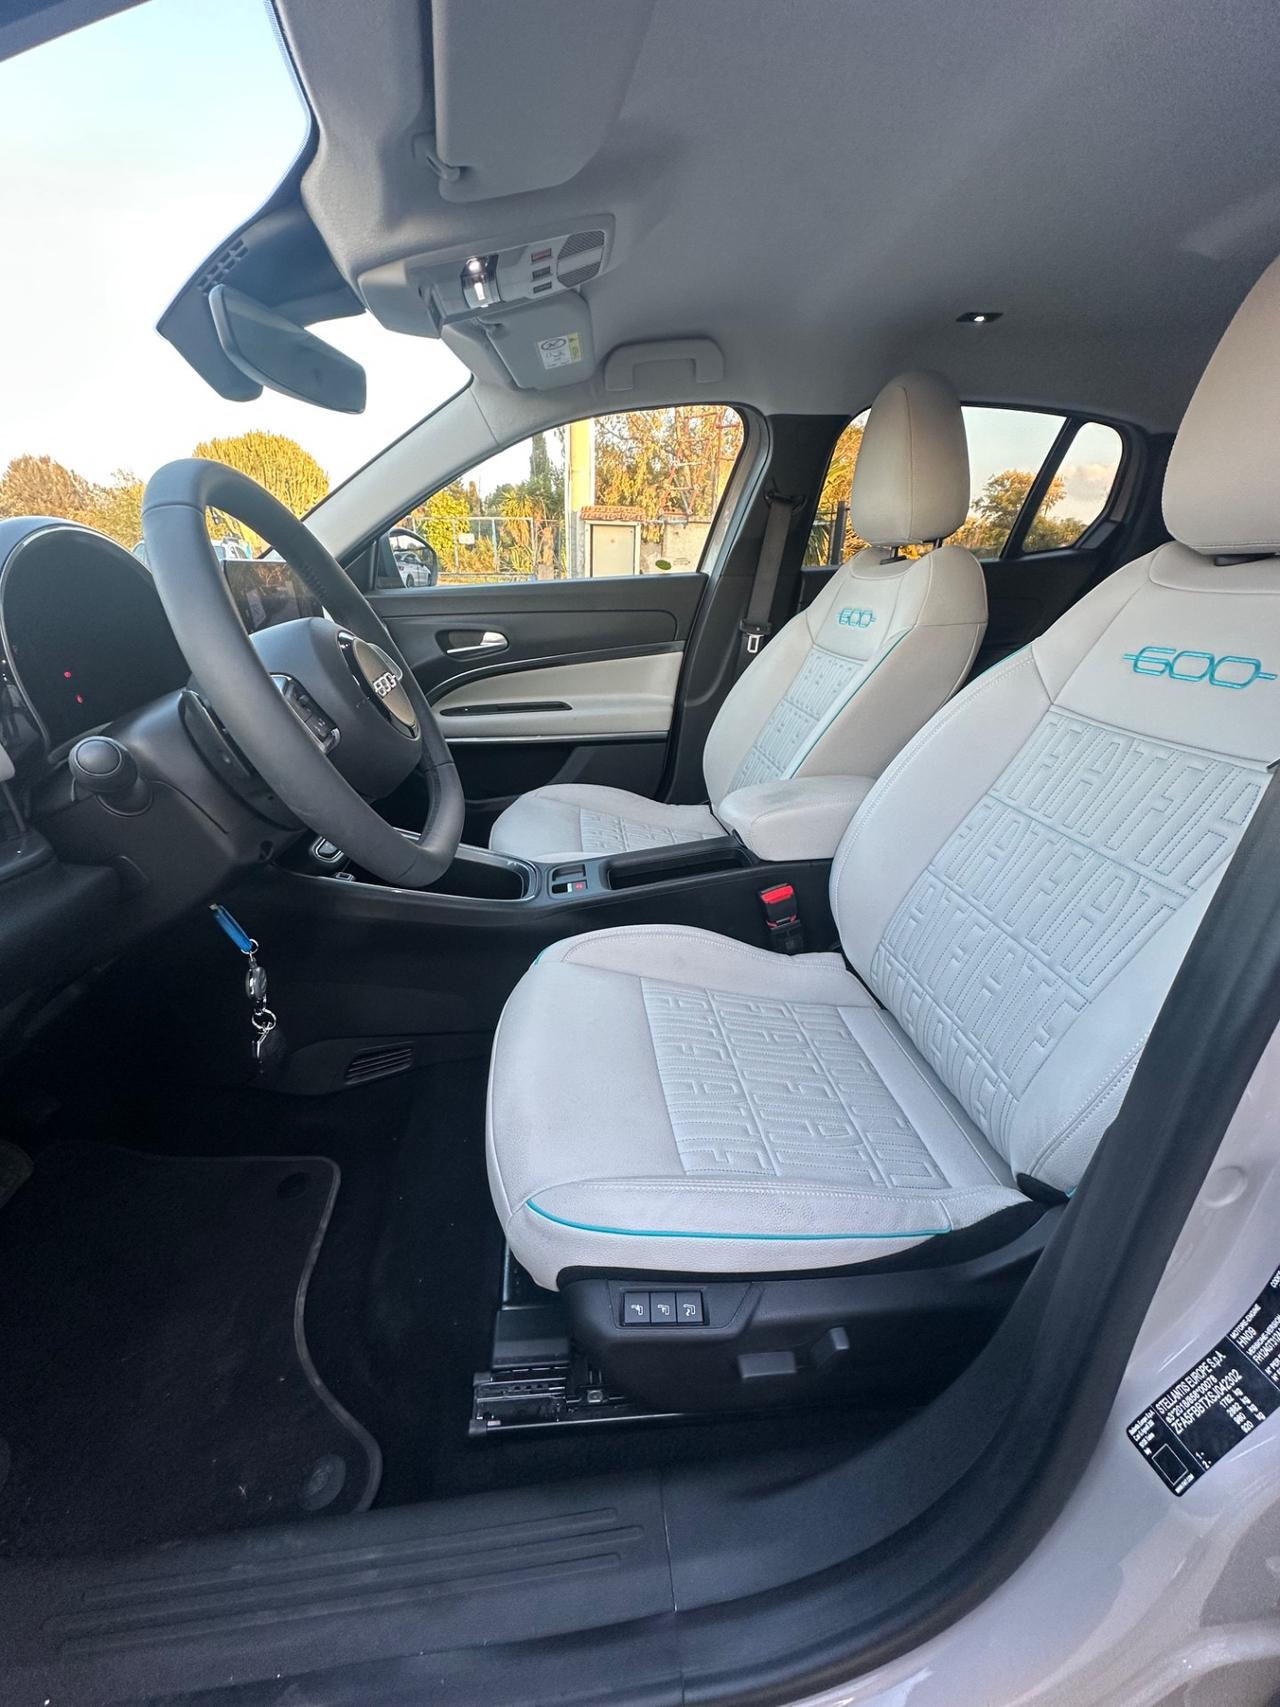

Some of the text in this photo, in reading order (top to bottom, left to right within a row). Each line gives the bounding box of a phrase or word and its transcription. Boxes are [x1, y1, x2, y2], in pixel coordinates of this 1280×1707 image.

[836, 607, 877, 628] 600
[1123, 646, 1279, 690] 600
[1236, 1327, 1257, 1348] HN09
[1156, 1382, 1190, 1414] STELLANTIS
[1185, 1362, 1213, 1388] EUROPE
